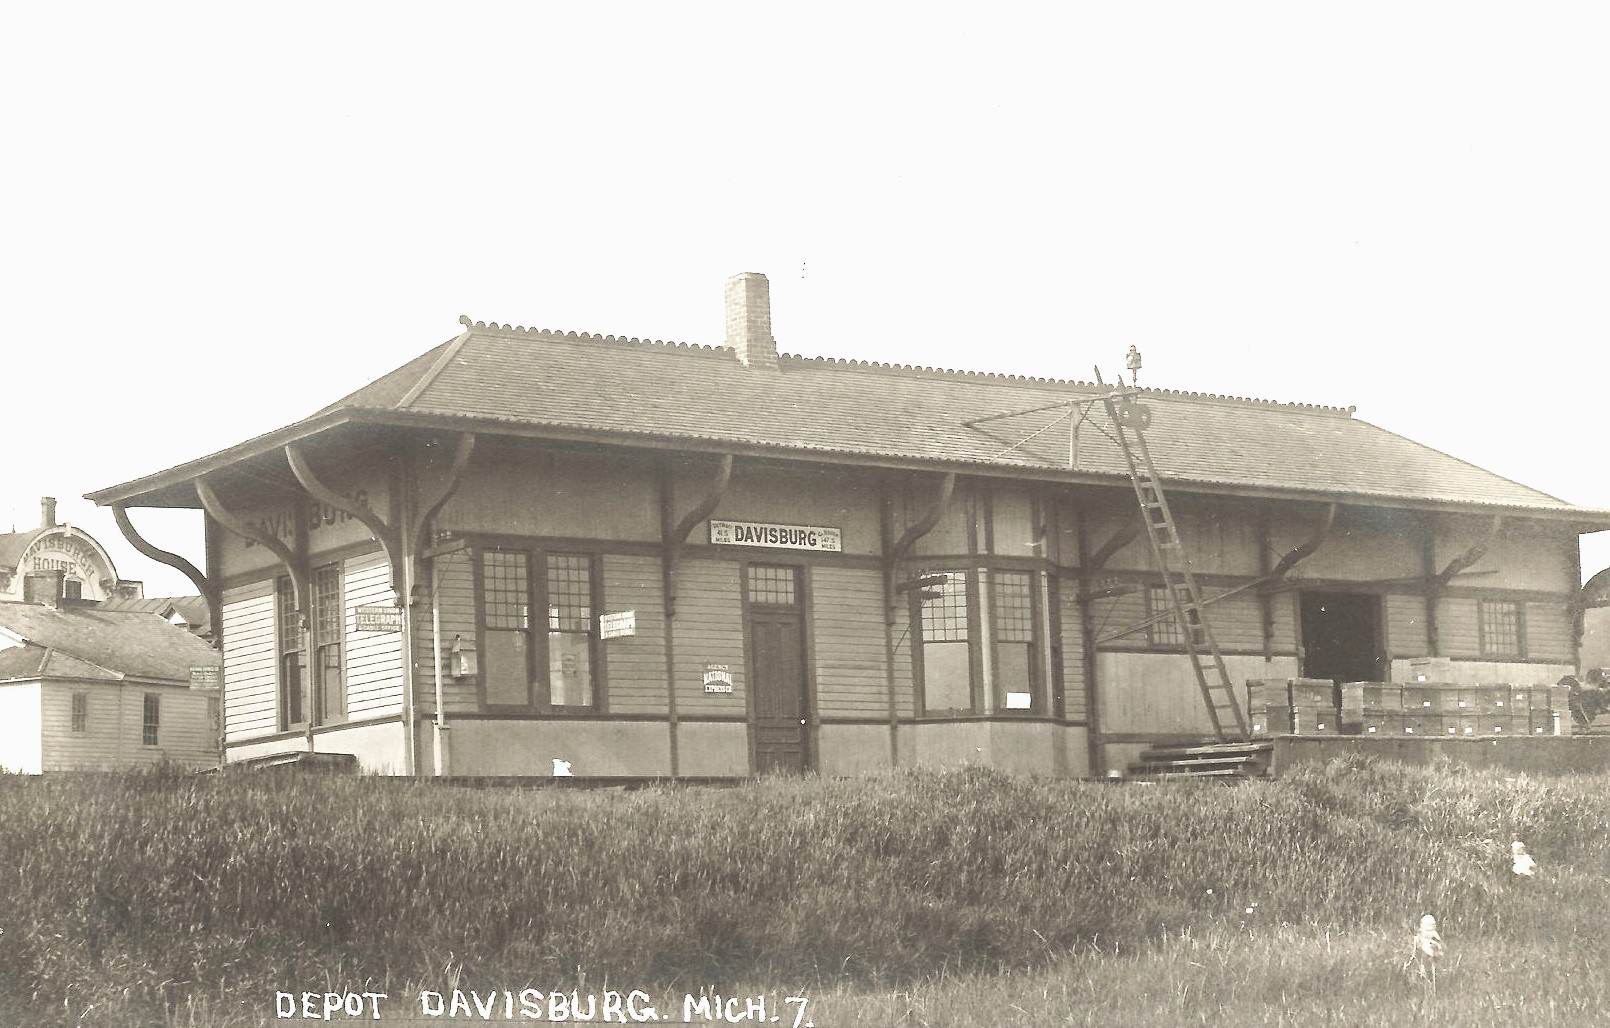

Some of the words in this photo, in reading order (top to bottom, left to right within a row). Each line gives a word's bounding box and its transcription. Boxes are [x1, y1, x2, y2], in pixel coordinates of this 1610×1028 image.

[734, 525, 817, 547] DAVISBURG
[33, 556, 77, 576] HOUSE
[355, 614, 402, 624] TELEGRAPH
[703, 670, 732, 685] NATIONAL
